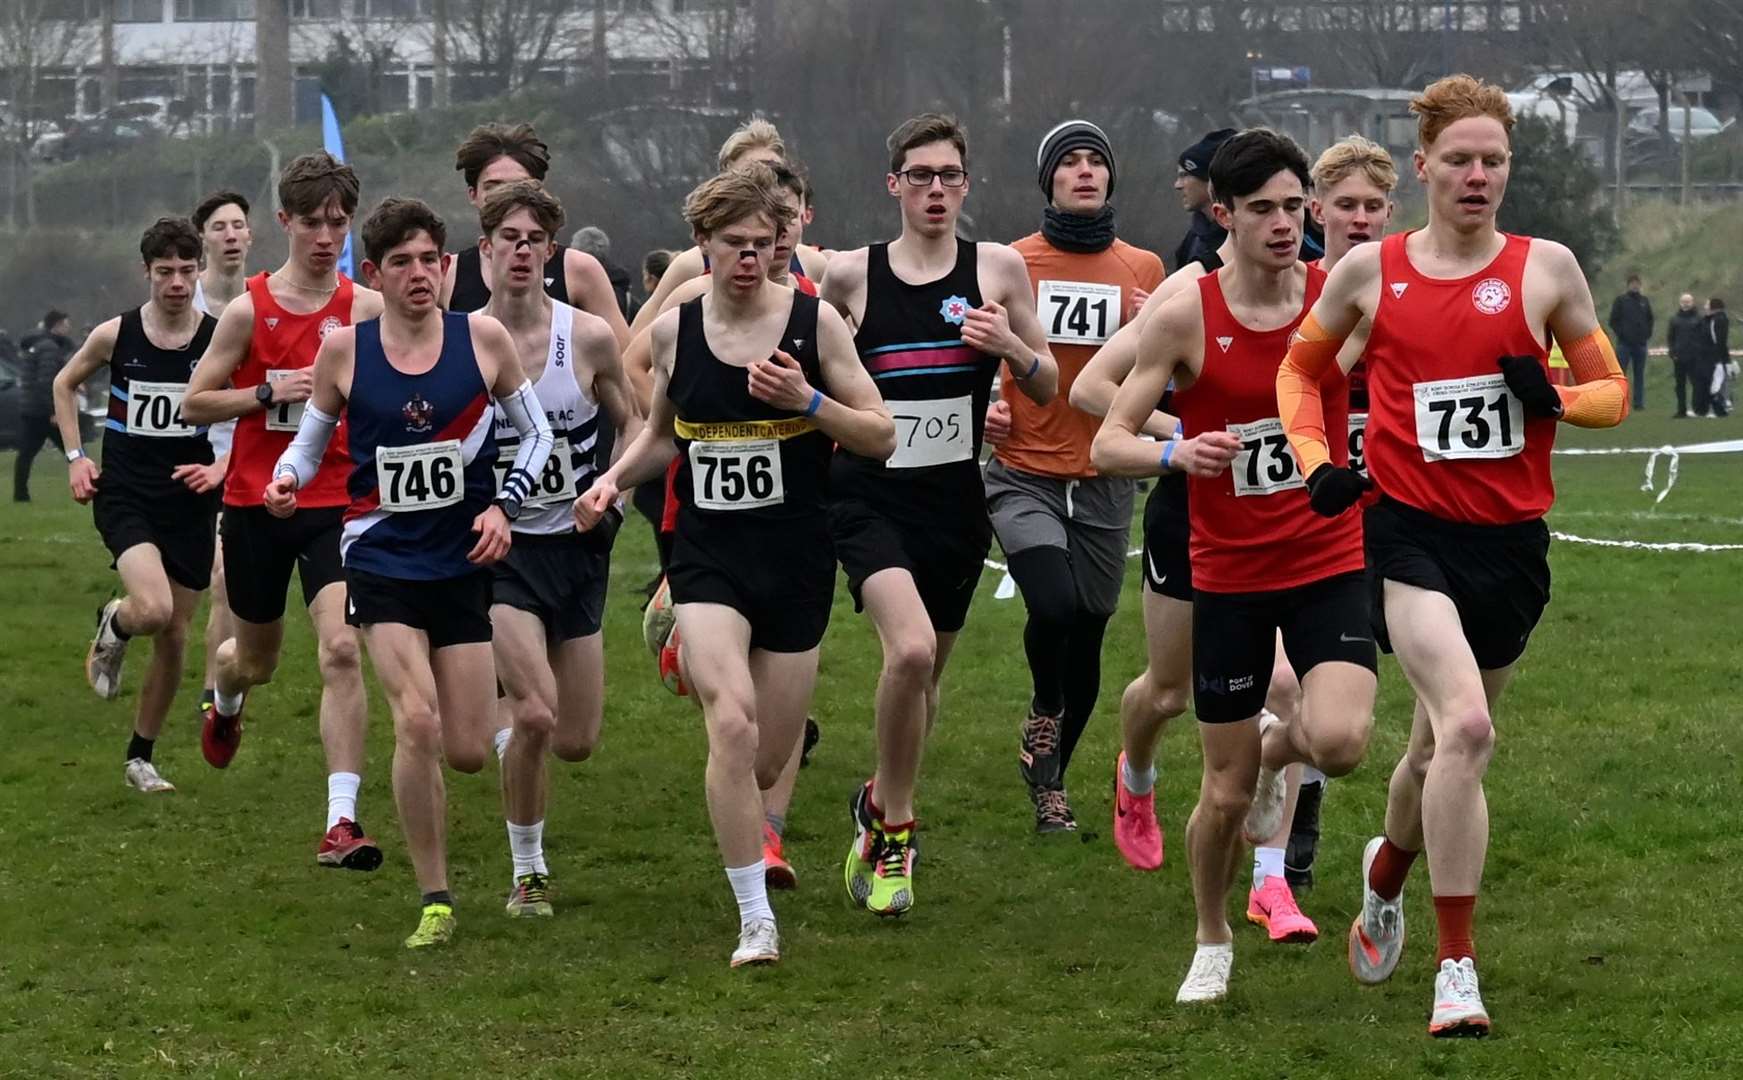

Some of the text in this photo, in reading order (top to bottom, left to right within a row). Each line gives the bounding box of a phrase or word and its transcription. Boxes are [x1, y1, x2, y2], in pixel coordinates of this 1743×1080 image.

[1050, 295, 1107, 337] 741
[555, 334, 565, 368] soar
[559, 410, 575, 421] AC
[893, 413, 959, 447] 705
[1429, 393, 1512, 450] 731
[384, 457, 455, 503] 746
[698, 455, 773, 501] 756
[1242, 434, 1304, 486] 73
[1230, 681, 1253, 691] DOVER
